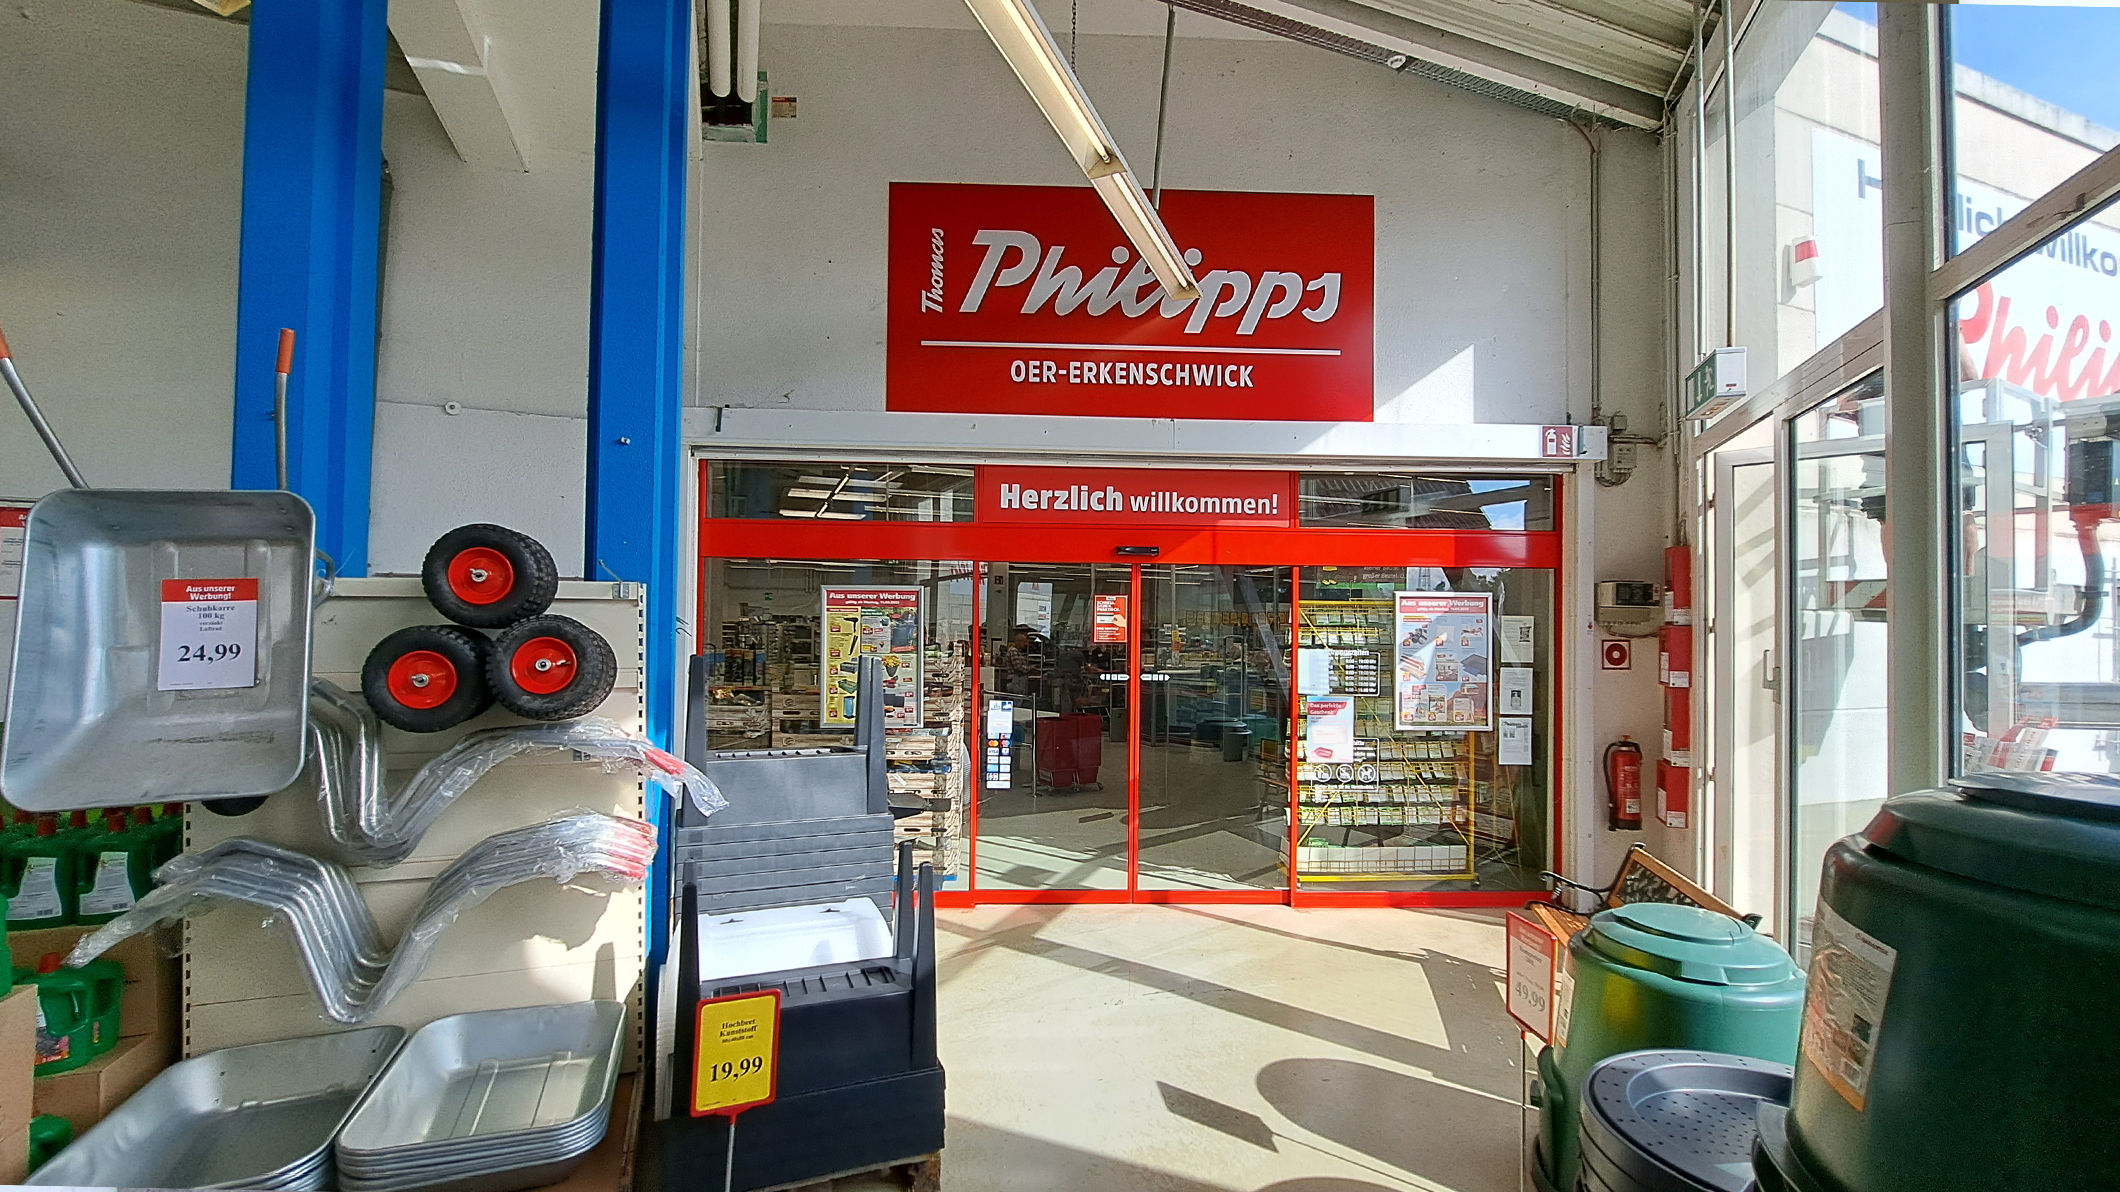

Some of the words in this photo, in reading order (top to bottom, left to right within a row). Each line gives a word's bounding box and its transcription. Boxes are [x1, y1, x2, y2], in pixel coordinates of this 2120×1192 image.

[921, 227, 945, 314] Thomas
[959, 229, 1342, 335] Philipps
[1010, 359, 1254, 389] OER-ERKENSCHWICK
[1000, 483, 1123, 512] Herzlich
[1130, 491, 1279, 515] willkommen!
[879, 593, 916, 601] Werbung
[1449, 600, 1484, 608] Werbung
[178, 643, 241, 664] 24,99
[720, 1025, 758, 1037] Kunststoff
[722, 1019, 755, 1029] Hochbeet
[710, 1055, 763, 1083] 19,99
